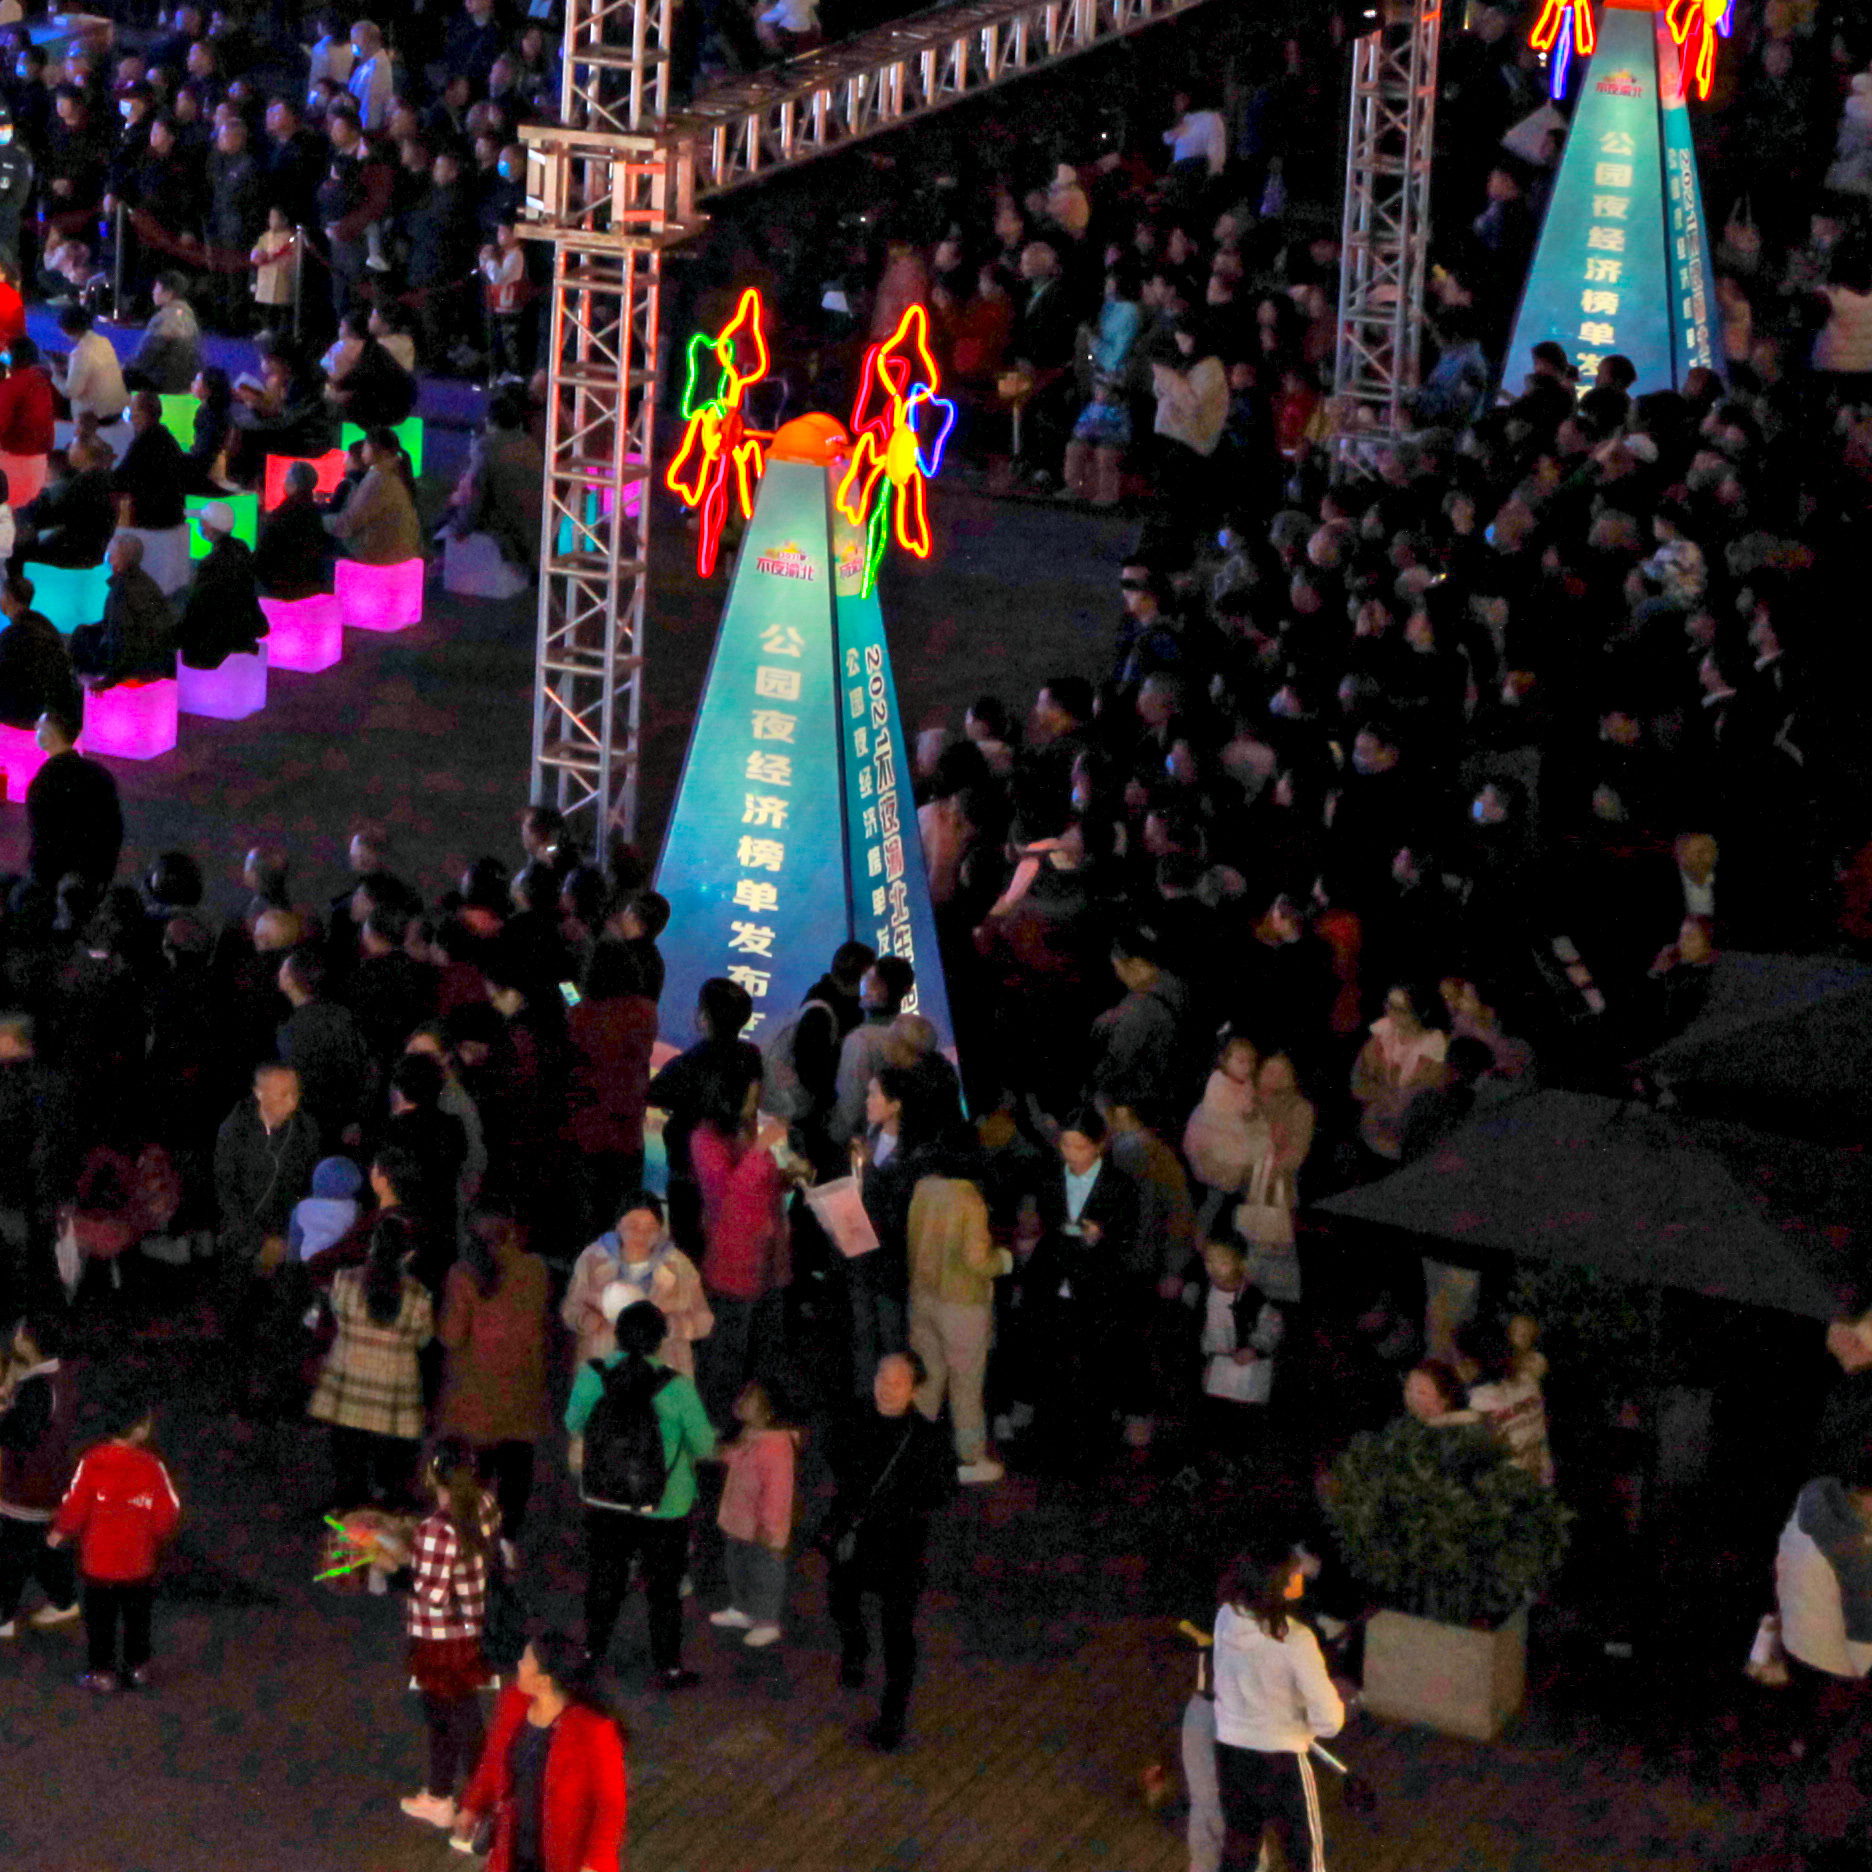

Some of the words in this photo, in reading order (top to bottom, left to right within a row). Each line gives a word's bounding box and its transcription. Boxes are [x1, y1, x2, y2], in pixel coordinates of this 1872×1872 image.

[1576, 131, 1635, 403] 公园夜经济榜单发
[755, 556, 815, 582] 不夜渝北
